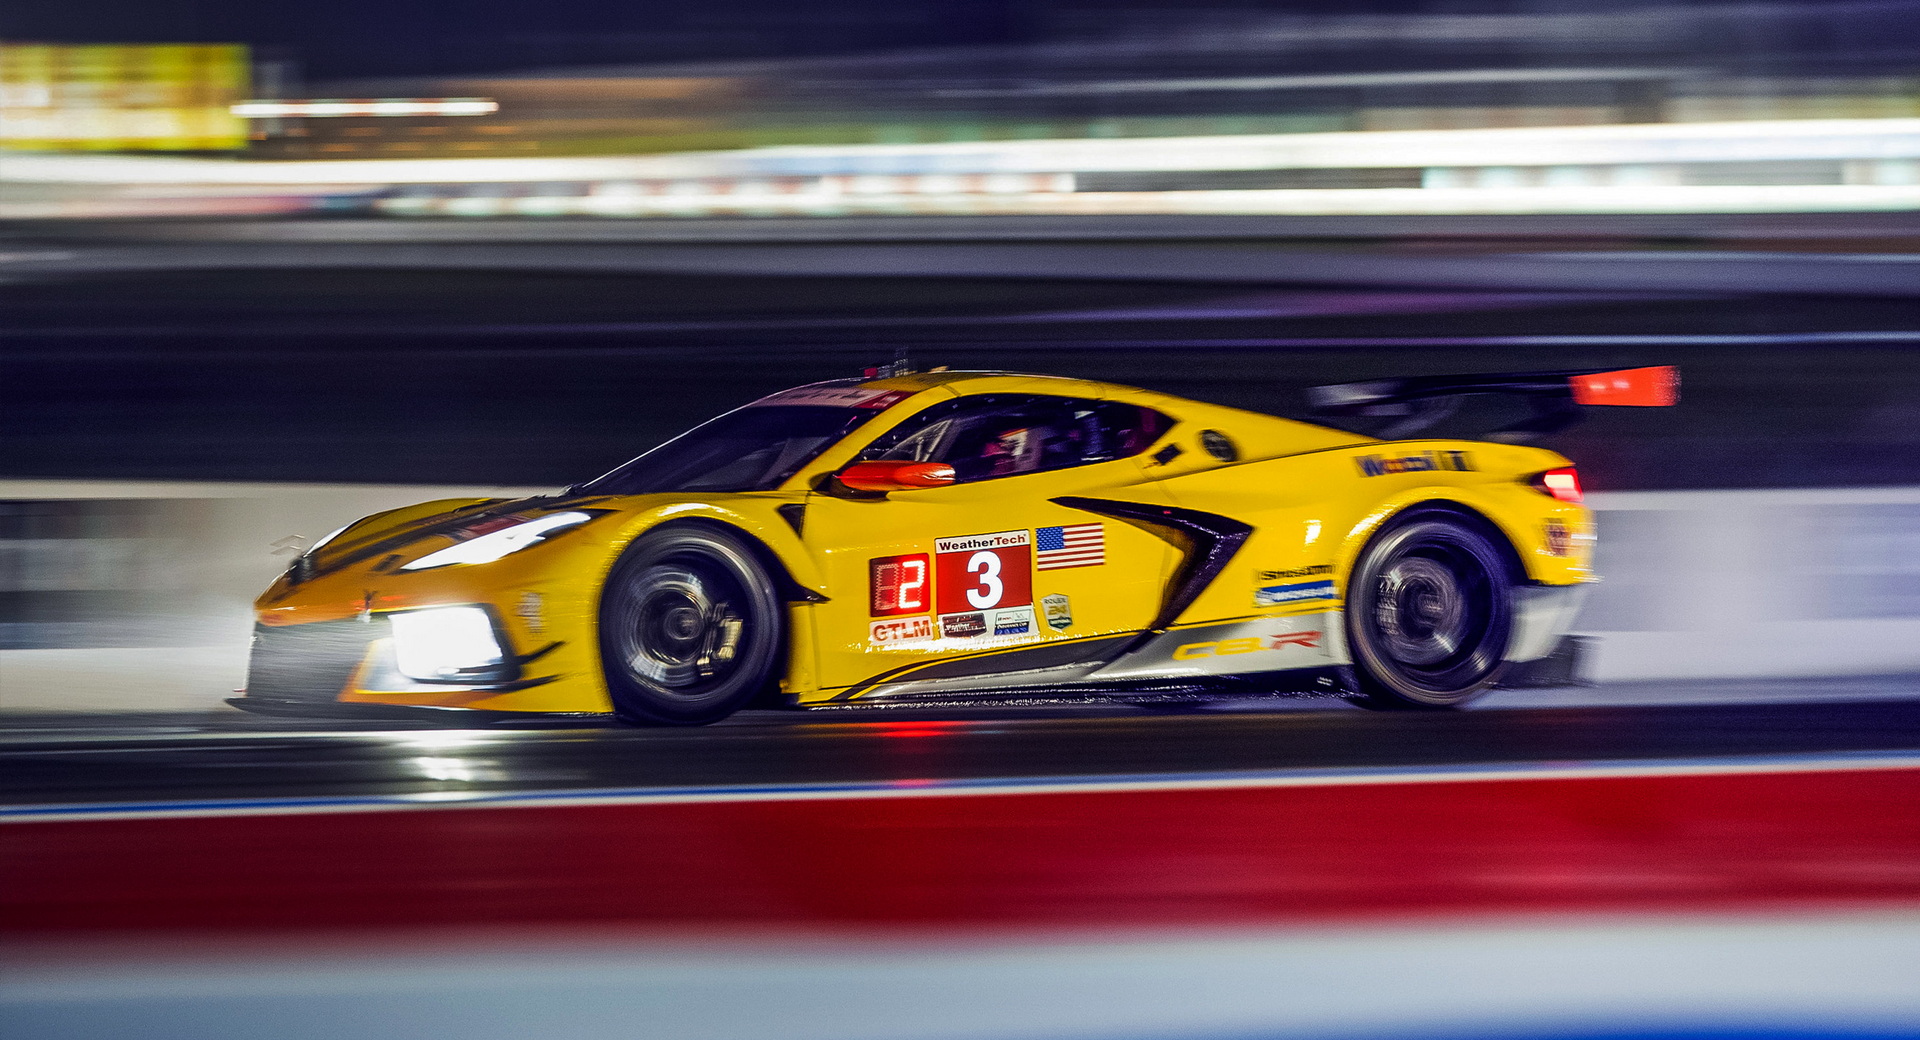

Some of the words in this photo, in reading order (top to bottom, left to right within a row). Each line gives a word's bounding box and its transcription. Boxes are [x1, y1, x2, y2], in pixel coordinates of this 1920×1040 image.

[938, 533, 1027, 551] WeatherTech
[966, 551, 1004, 610] 3
[873, 619, 931, 642] GTLM
